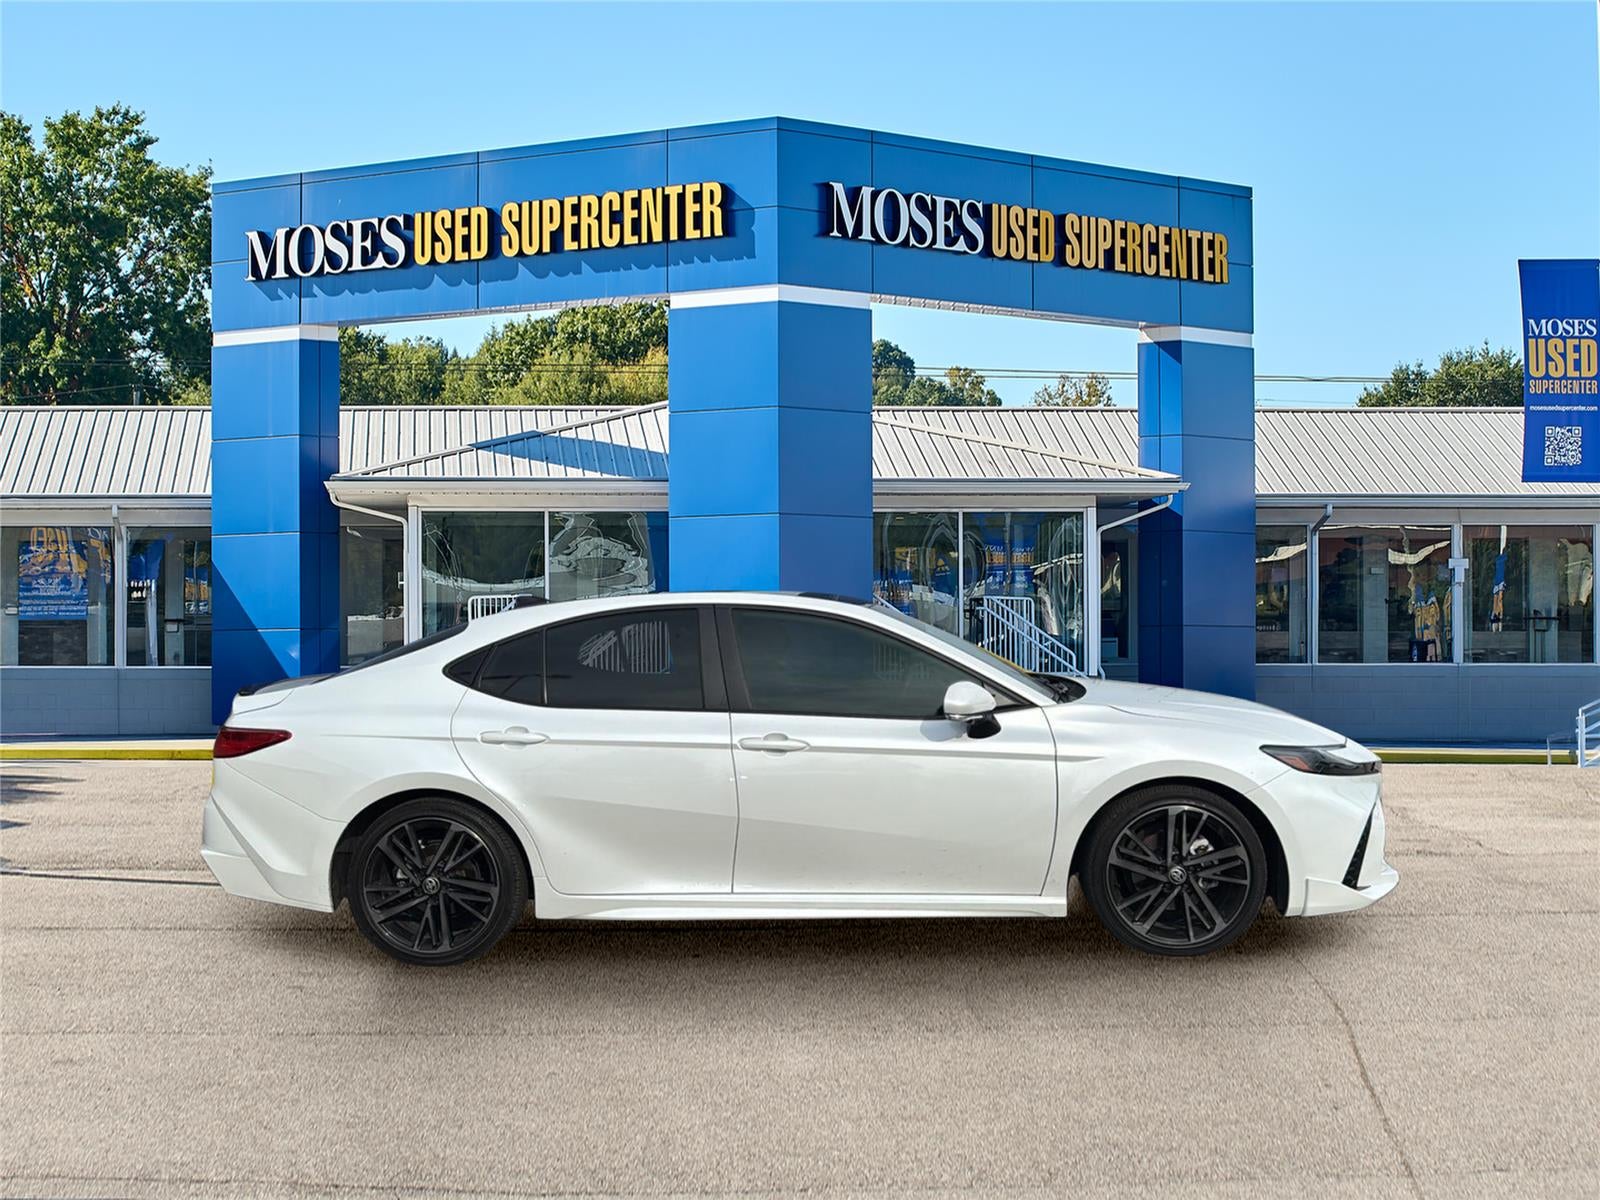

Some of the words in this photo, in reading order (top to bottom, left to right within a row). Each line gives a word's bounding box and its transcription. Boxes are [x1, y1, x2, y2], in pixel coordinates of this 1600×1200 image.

[246, 214, 407, 282] MOSES
[413, 205, 489, 266] USED
[500, 181, 725, 258] SUPERCENTER
[828, 181, 985, 255] MOSES
[991, 203, 1056, 263] USED
[1065, 213, 1230, 284] SUPERCENTER
[1527, 318, 1597, 337] MOSES
[1527, 338, 1598, 378] USED
[1529, 379, 1598, 395] SUPERCENTER
